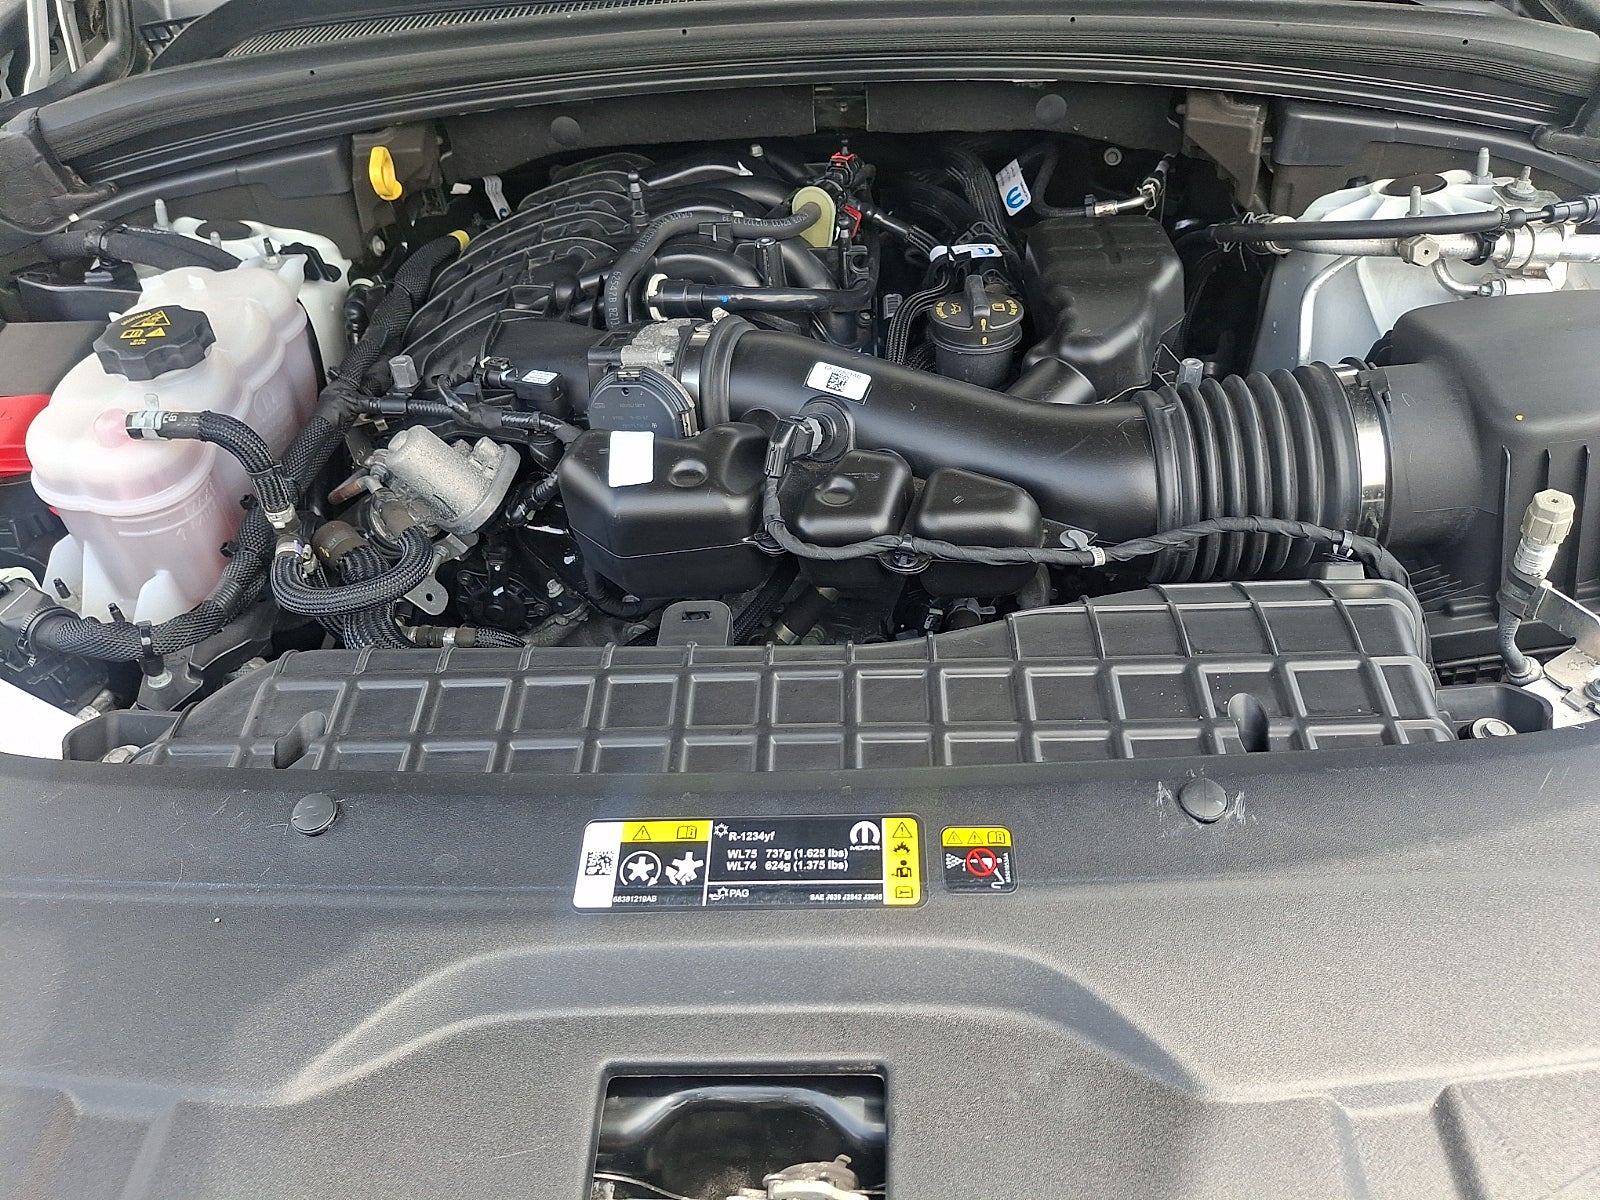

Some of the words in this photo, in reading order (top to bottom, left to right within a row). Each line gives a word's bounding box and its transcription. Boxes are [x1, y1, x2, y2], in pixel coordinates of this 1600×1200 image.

[728, 831, 776, 843] R-1234yf
[727, 849, 758, 859] WL75
[765, 848, 792, 861] 737g
[793, 848, 826, 860] (1.625
[827, 848, 849, 860] lbs)
[726, 861, 757, 871] WL74
[764, 860, 792, 872] 624g
[793, 860, 826, 873] (1.375
[827, 860, 849, 872] lbs)
[729, 889, 750, 898] PAG
[810, 893, 825, 901] SAE
